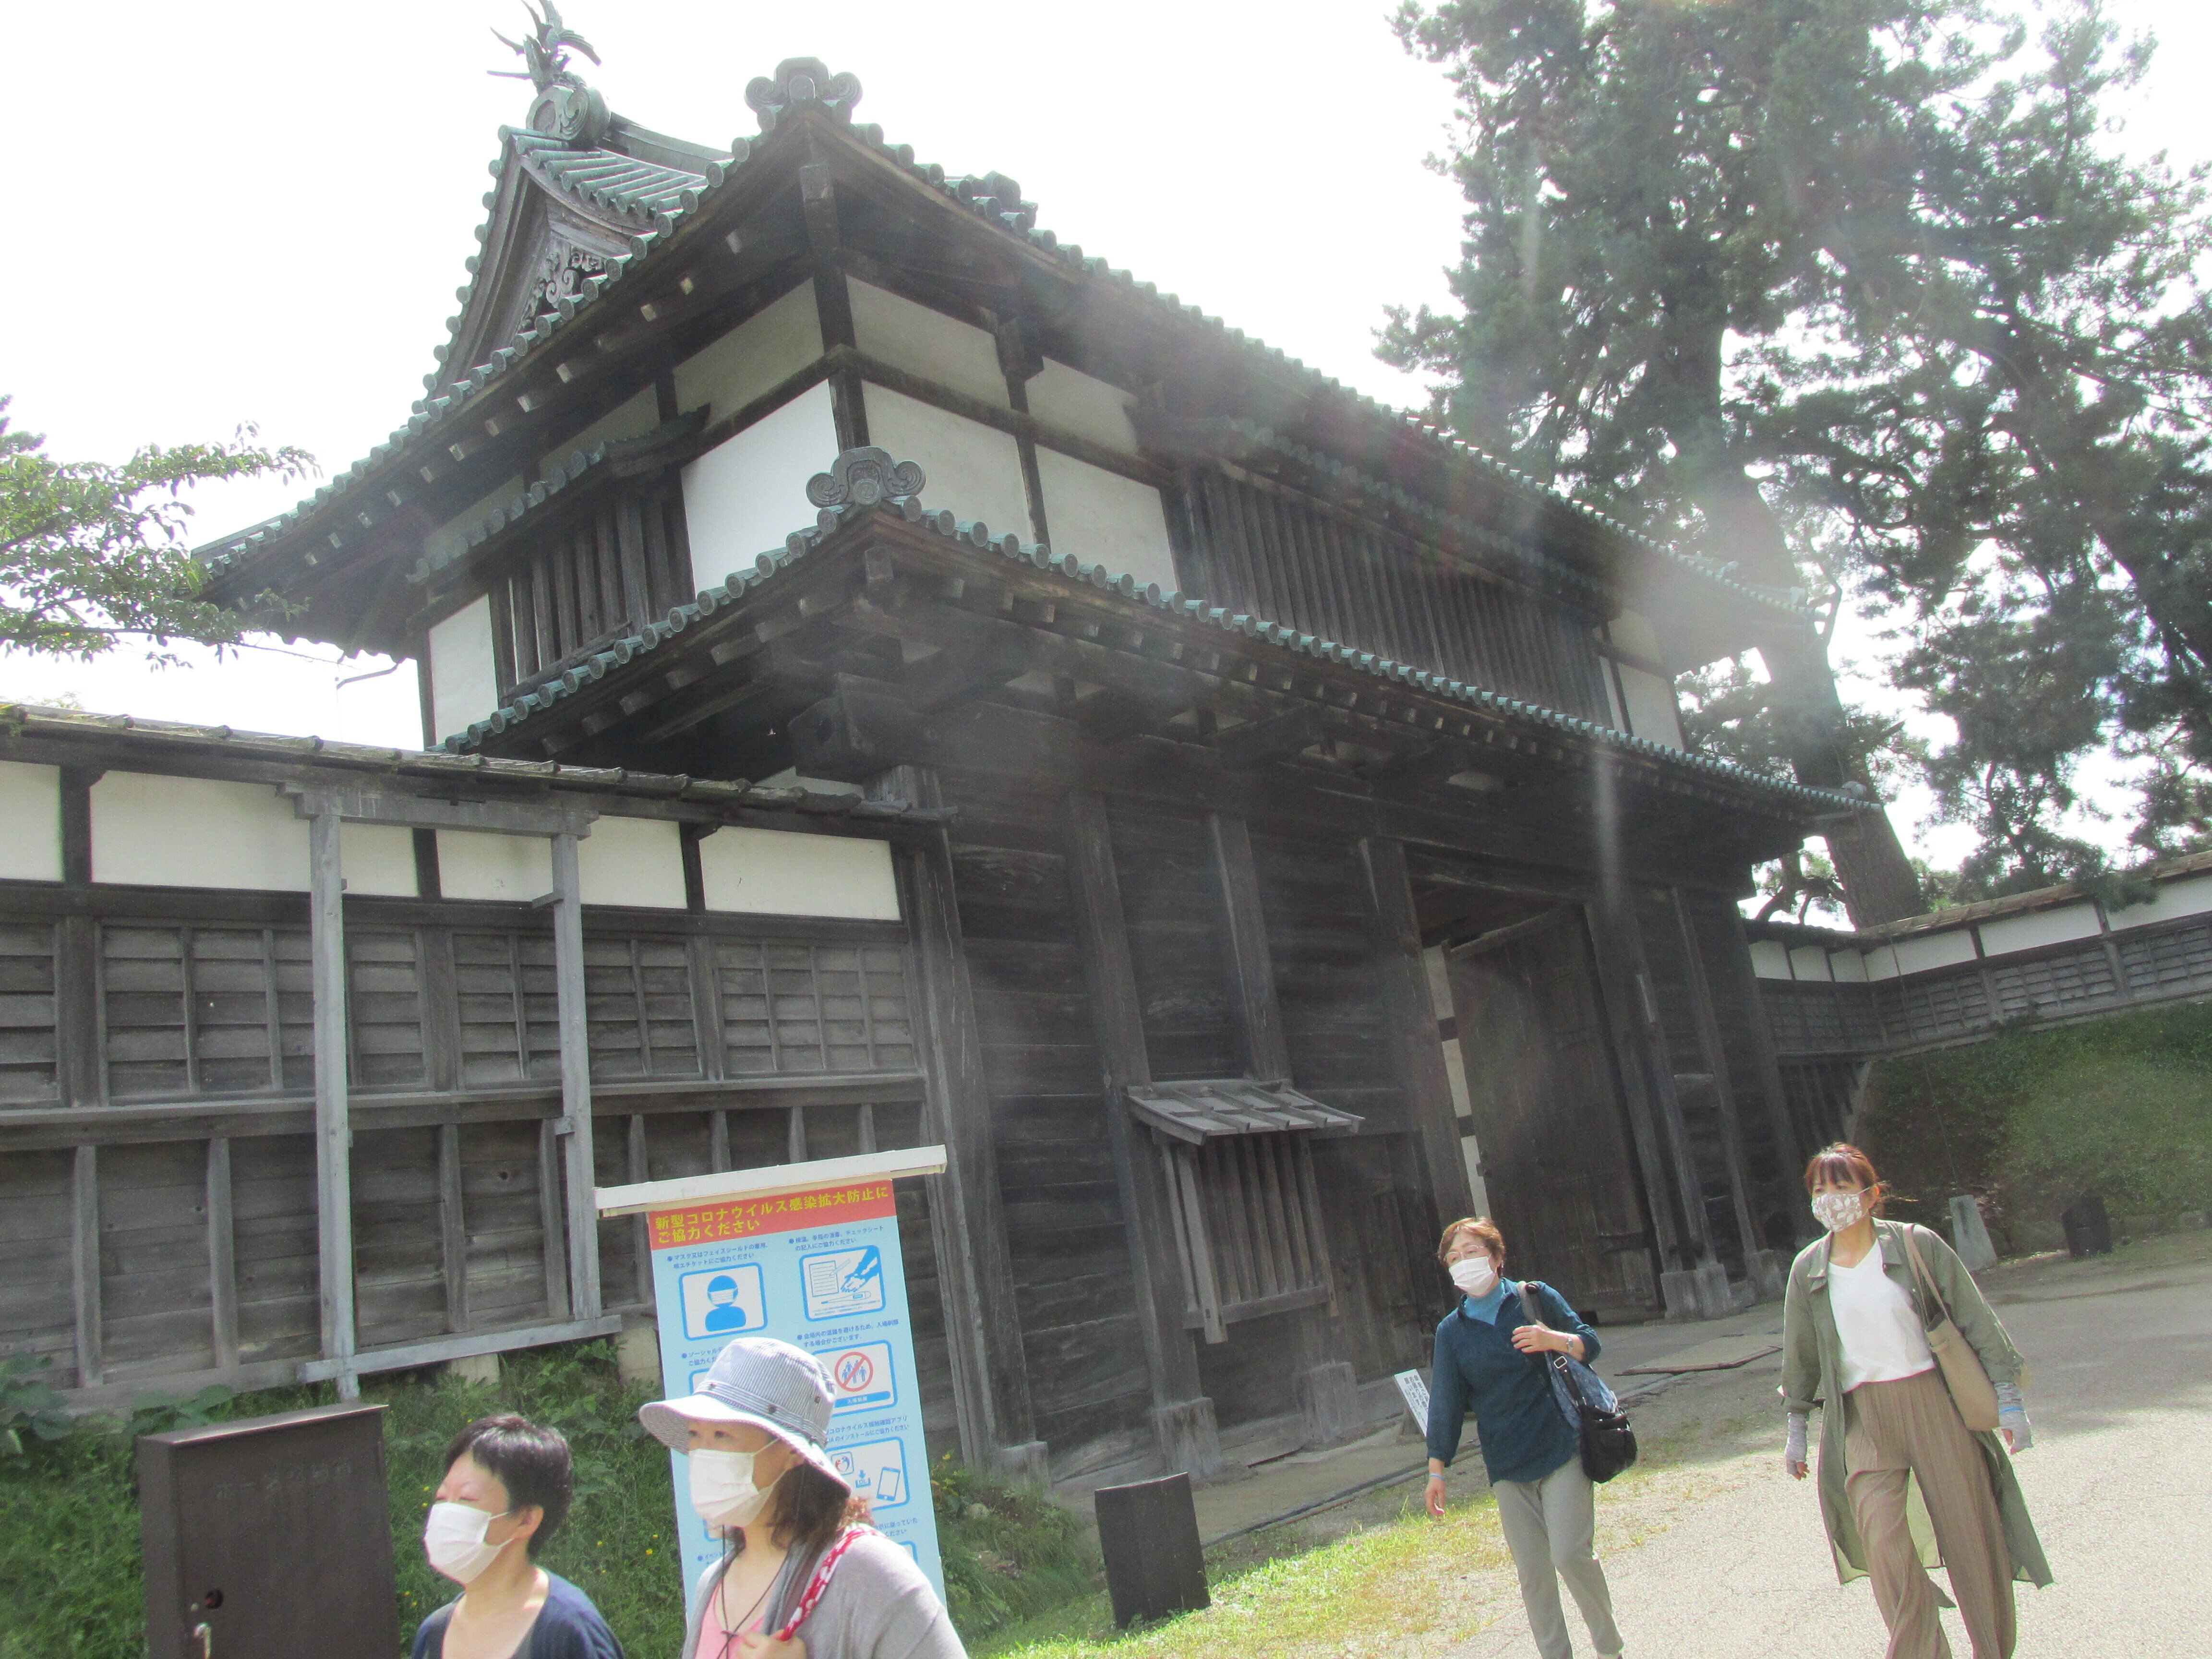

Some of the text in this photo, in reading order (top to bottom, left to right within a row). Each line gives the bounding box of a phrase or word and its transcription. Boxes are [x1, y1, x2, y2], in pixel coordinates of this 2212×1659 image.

[655, 1187, 888, 1230] 新型コロナウイルス感染拡大防止に
[658, 1219, 760, 1243] ご協力ください
